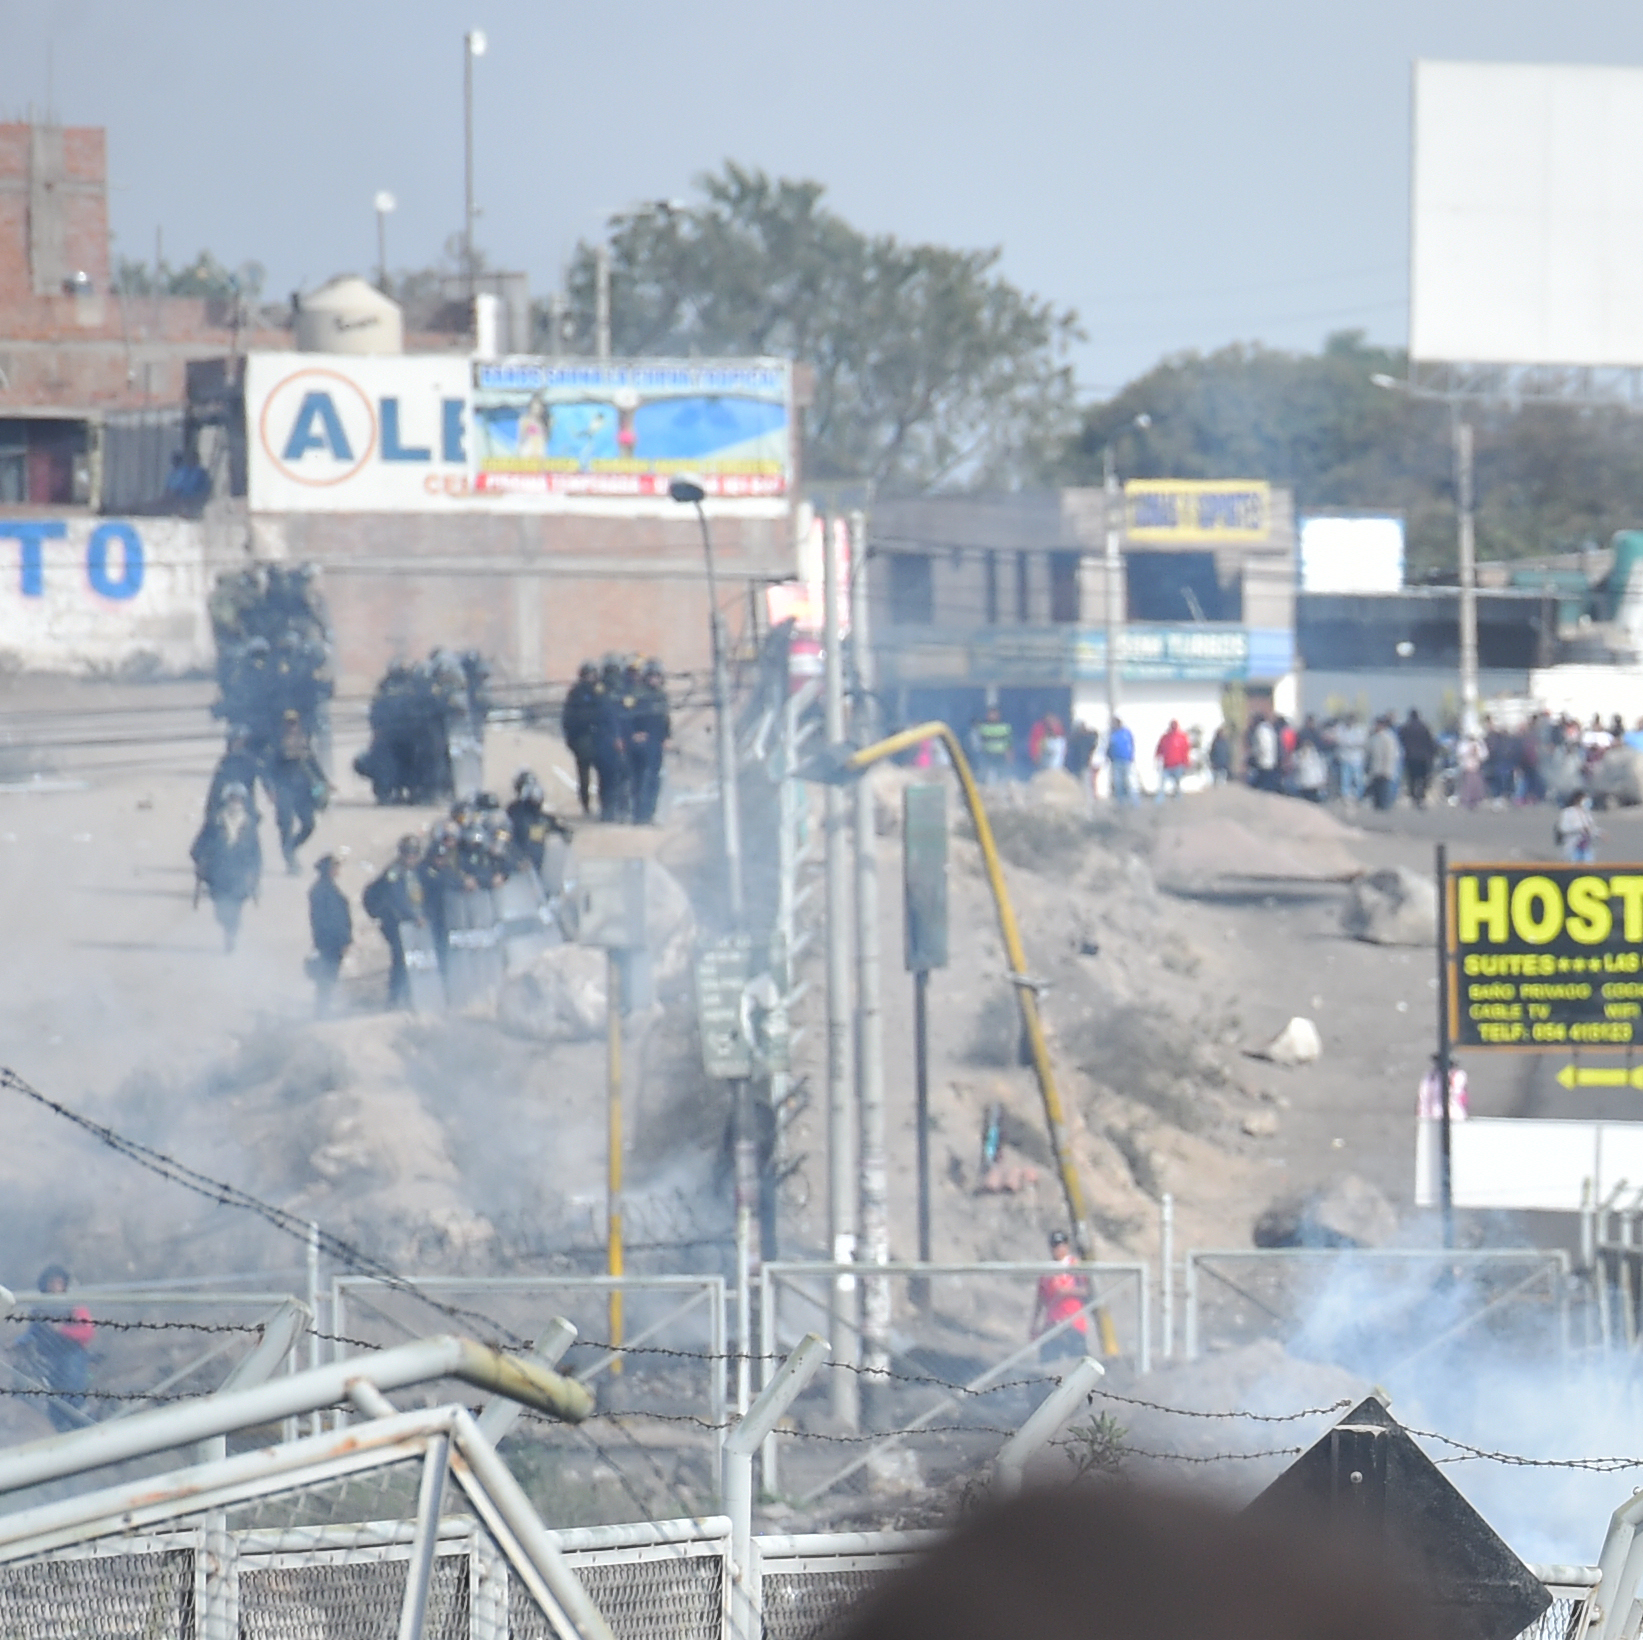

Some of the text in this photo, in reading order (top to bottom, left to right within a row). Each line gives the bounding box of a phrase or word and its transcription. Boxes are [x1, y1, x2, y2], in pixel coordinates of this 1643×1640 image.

[0, 521, 144, 600] TO
[1464, 953, 1557, 976] SUITES
[1603, 952, 1640, 973] LAS
[1468, 981, 1516, 1001] BAÑO
[1519, 982, 1592, 1000] PRIVADO
[1469, 1003, 1523, 1020] CABLE
[1527, 1003, 1551, 1020] TV
